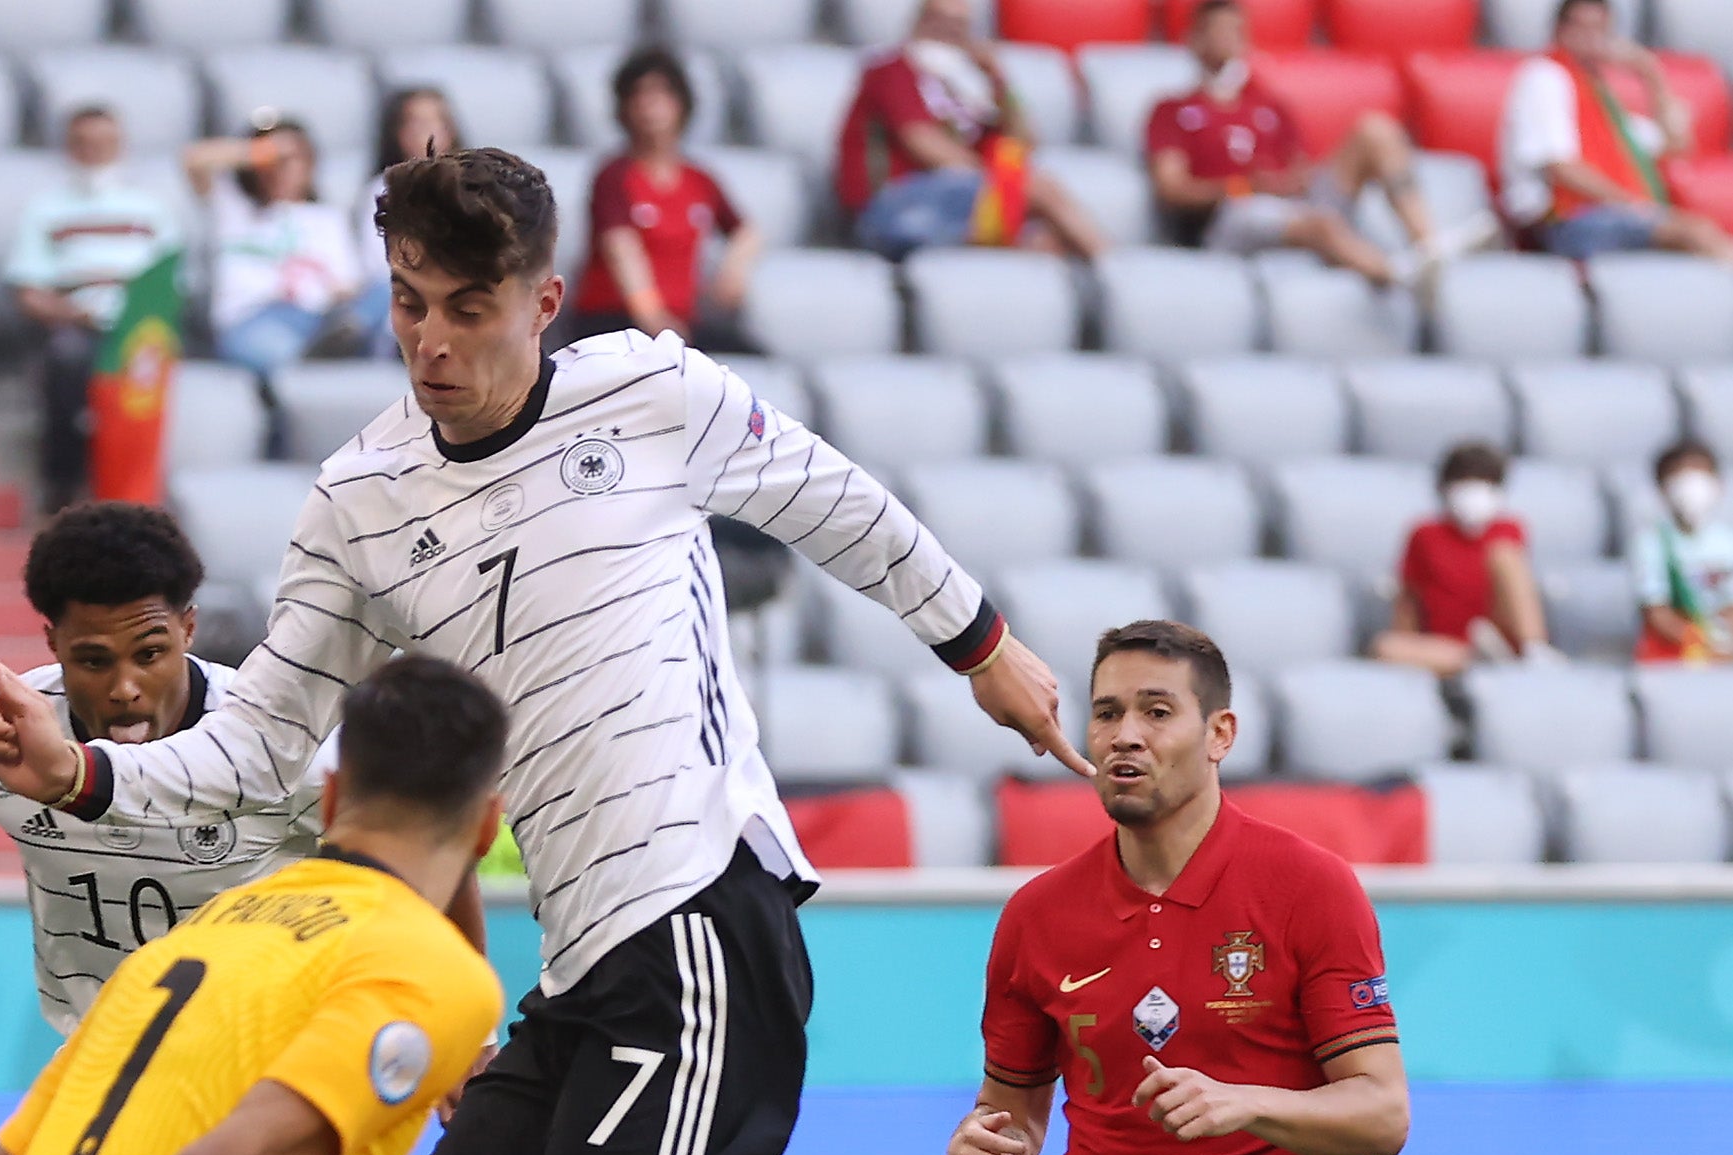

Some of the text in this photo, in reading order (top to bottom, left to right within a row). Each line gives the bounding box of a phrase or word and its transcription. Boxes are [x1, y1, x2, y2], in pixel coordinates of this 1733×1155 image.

[477, 546, 519, 656] 7
[68, 871, 177, 950] 10
[586, 1045, 666, 1147] 7
[1069, 1013, 1105, 1096] 5
